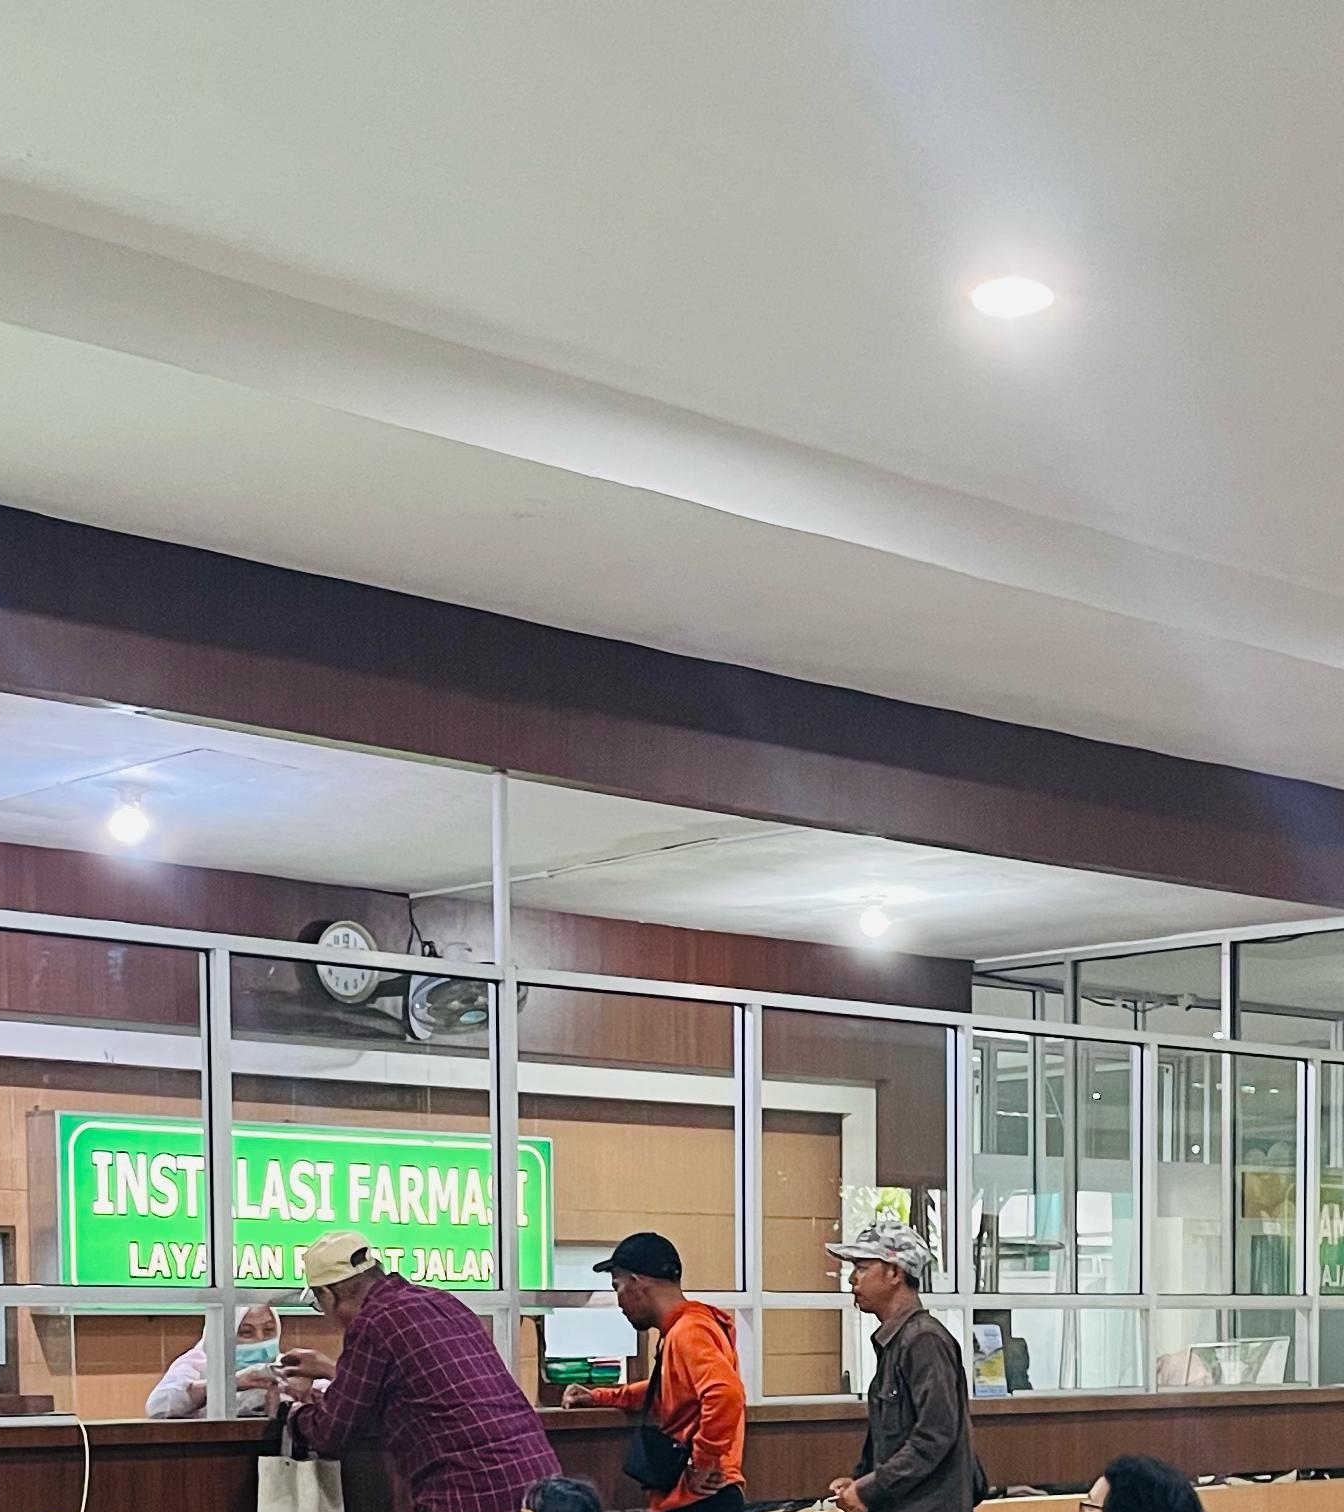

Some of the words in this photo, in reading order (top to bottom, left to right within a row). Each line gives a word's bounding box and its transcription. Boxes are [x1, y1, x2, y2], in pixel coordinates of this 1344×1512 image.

[92, 1150, 336, 1222] INSTLASI
[348, 1163, 530, 1228] FARMAI
[129, 1241, 284, 1281] LAYAAN
